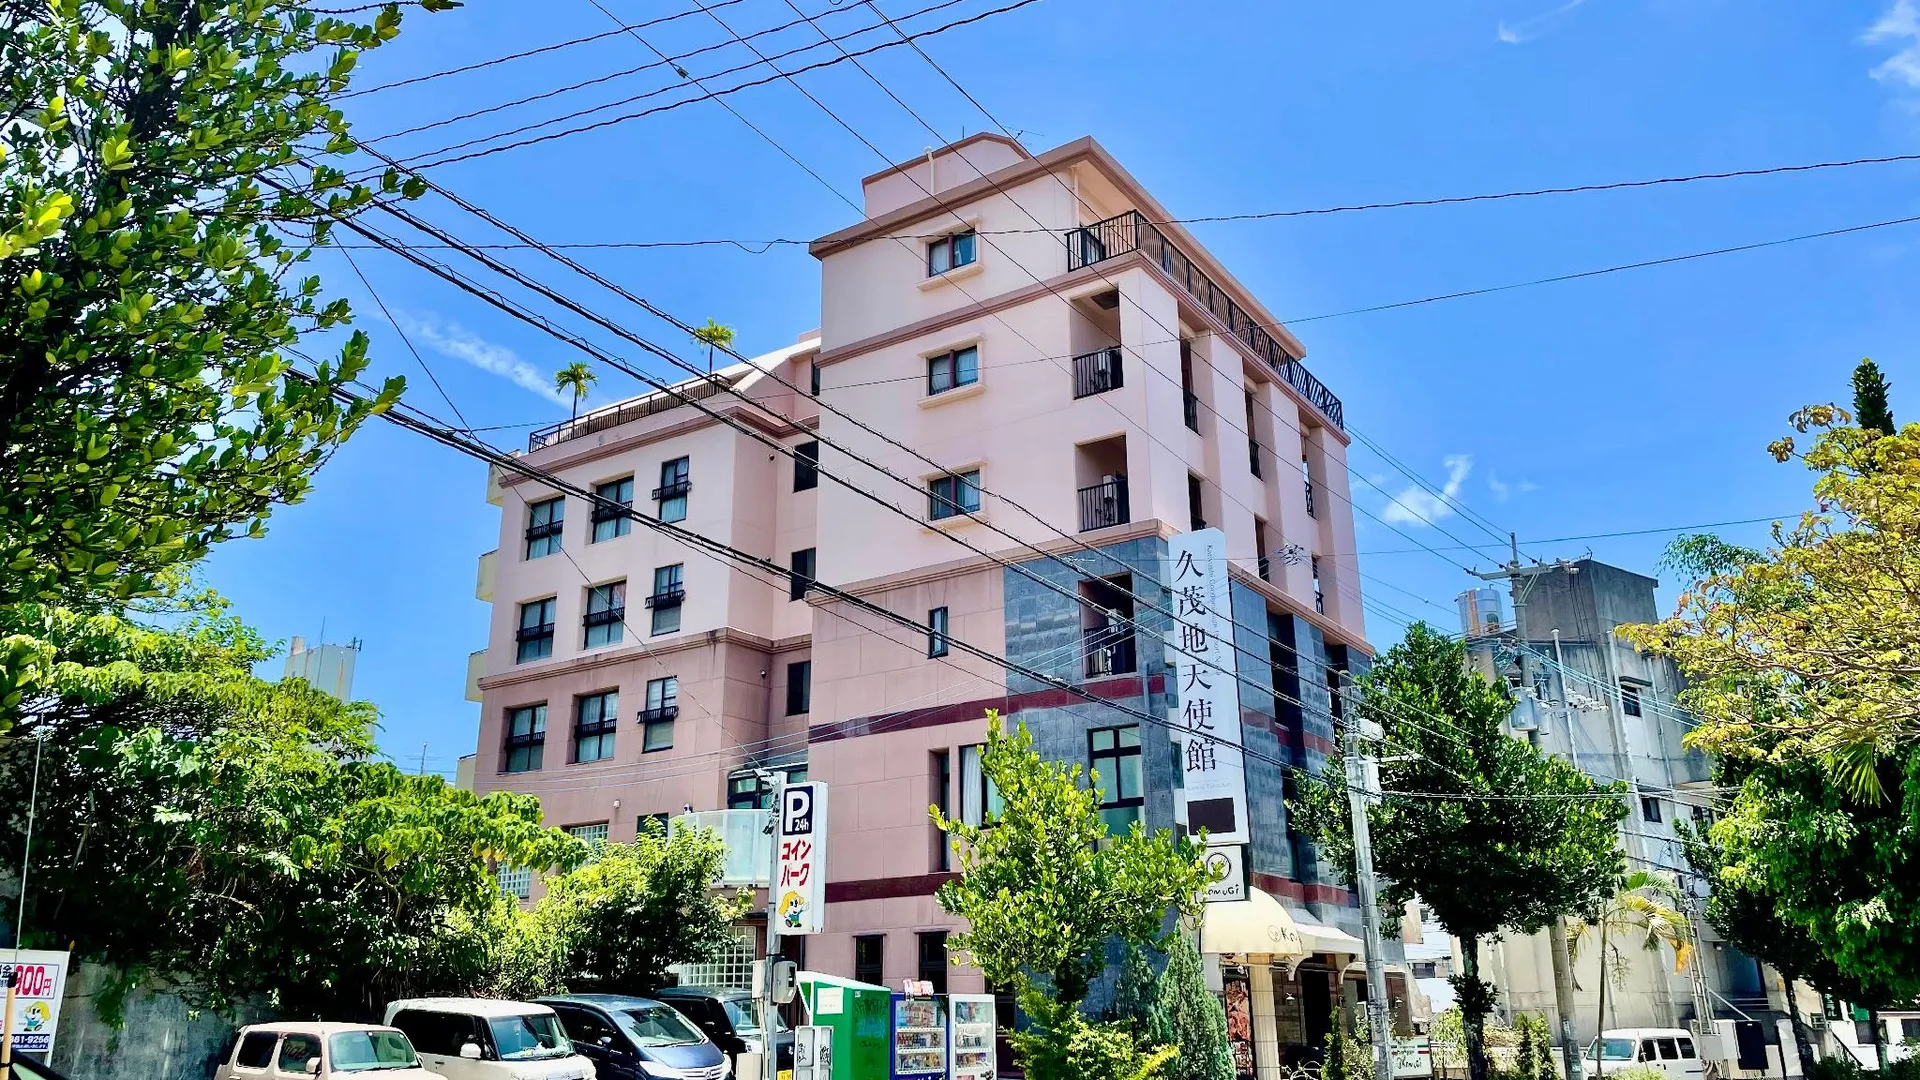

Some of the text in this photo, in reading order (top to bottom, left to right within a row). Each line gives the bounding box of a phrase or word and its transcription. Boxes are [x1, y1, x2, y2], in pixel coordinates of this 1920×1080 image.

[1175, 550, 1216, 772] 久茂地天使館
[785, 790, 810, 832] P
[794, 818, 810, 831] 24h
[781, 840, 811, 860] コイン
[781, 863, 810, 887] パーク
